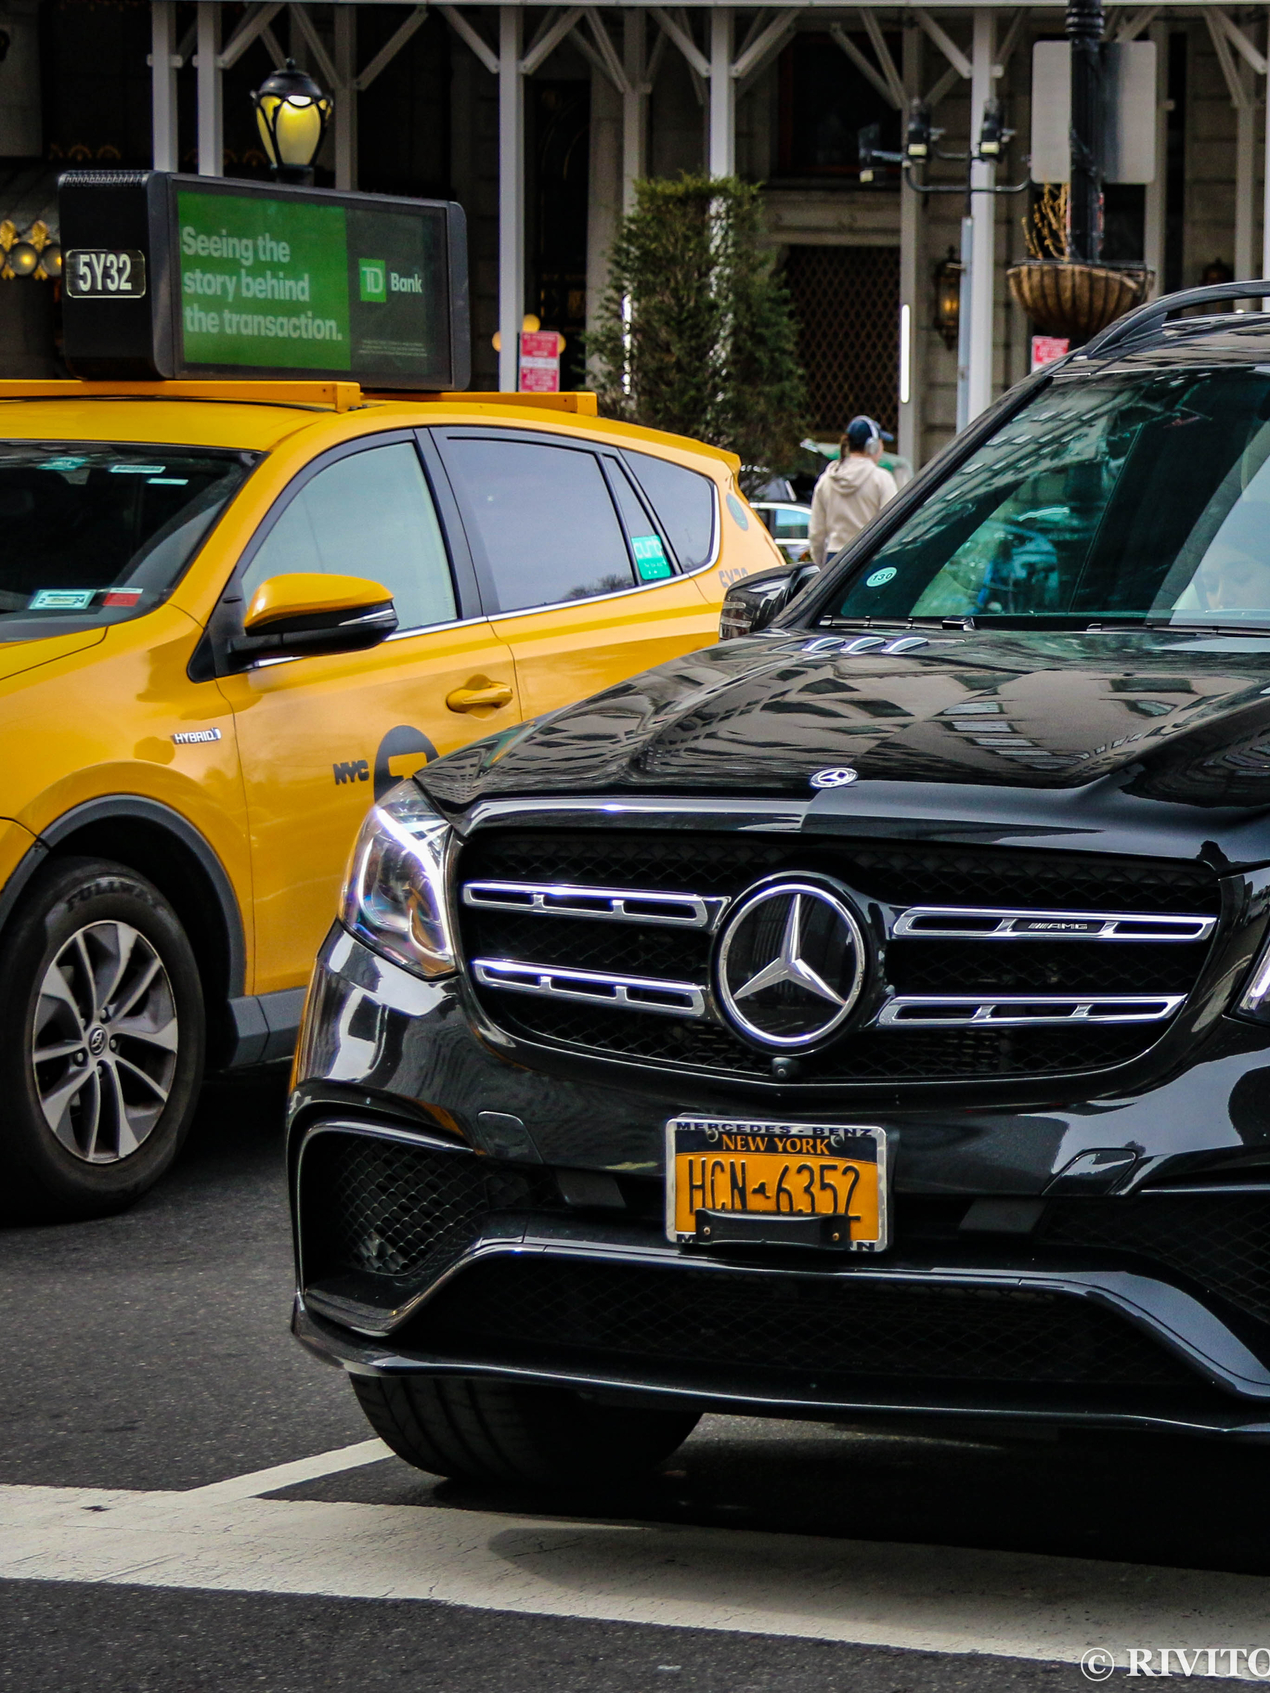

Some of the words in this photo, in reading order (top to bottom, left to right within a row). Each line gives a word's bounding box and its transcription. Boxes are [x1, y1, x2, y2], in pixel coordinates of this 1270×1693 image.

[182, 226, 254, 266] Seeing
[257, 233, 291, 263] the
[79, 253, 132, 292] 5Y32
[183, 269, 237, 302] story
[240, 269, 310, 302] behind
[361, 266, 384, 294] TD
[390, 272, 423, 293] Bank
[184, 303, 220, 334] the
[223, 309, 343, 341] transaction.
[173, 730, 216, 744] HYBRID
[332, 760, 370, 785] NYC
[721, 1133, 768, 1151] NEW
[774, 1137, 831, 1155] YORK
